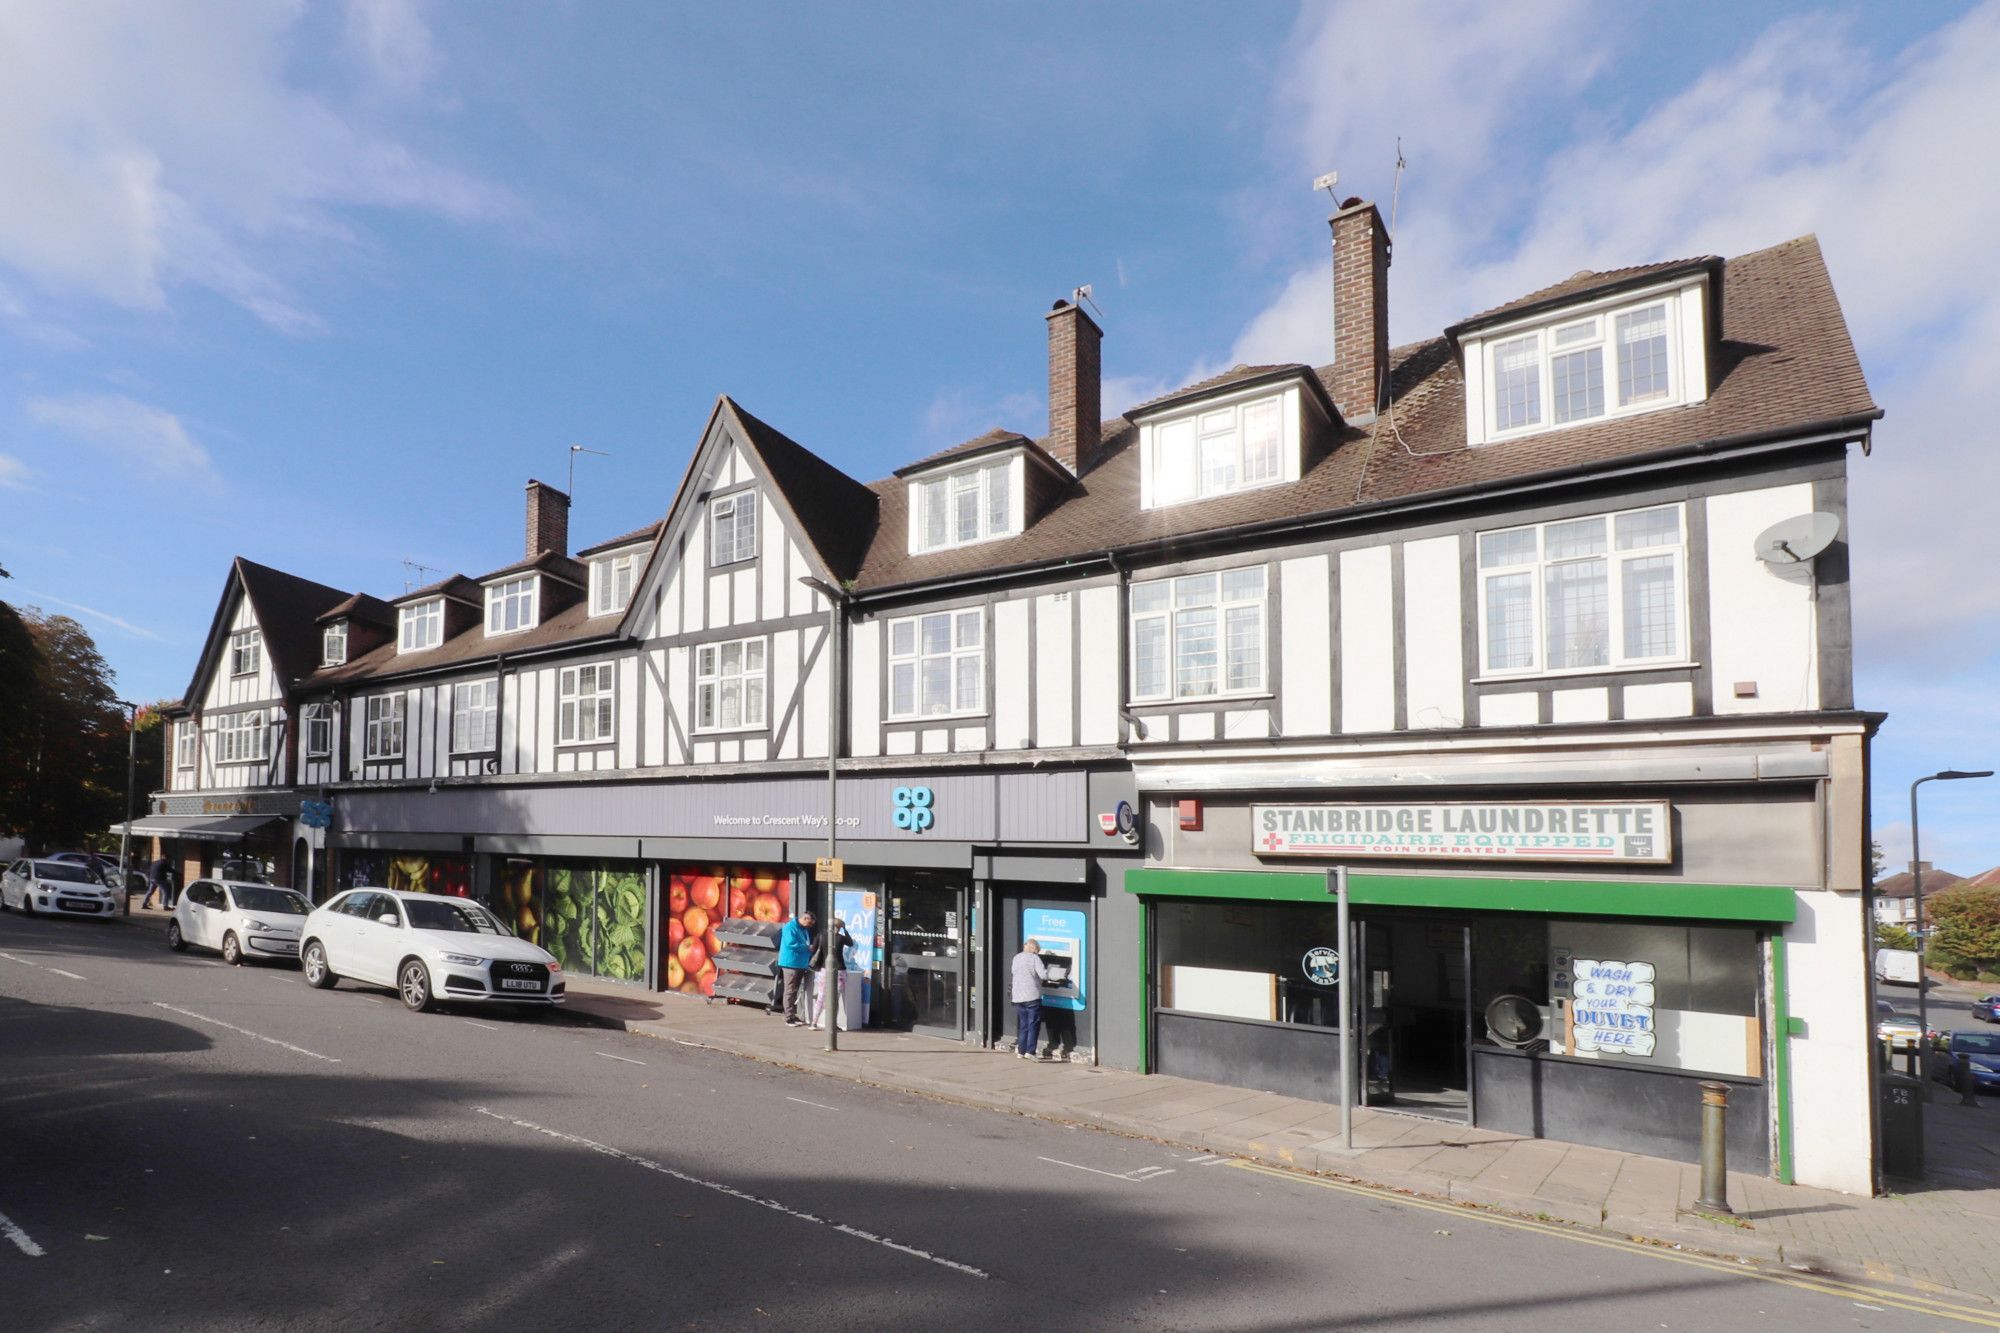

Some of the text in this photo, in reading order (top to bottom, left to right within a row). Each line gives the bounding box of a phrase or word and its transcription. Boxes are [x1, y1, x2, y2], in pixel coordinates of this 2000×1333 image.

[714, 815, 750, 825] Welcome
[752, 815, 761, 825] to
[763, 815, 800, 825] Crescent
[802, 815, 828, 827] Way's
[1263, 808, 1653, 833] STANBRIDGE LAUNDRETTE
[1289, 834, 1616, 847] FRIGIDAIRE EQUIPPED
[1418, 846, 1508, 854] OPERATED
[1041, 915, 1067, 927] Free
[1590, 967, 1633, 981] WASH
[1586, 983, 1636, 997] & DRY
[1587, 999, 1617, 1008] YOUR
[1576, 1009, 1649, 1030] DUVET
[1594, 1031, 1635, 1044] HERE
